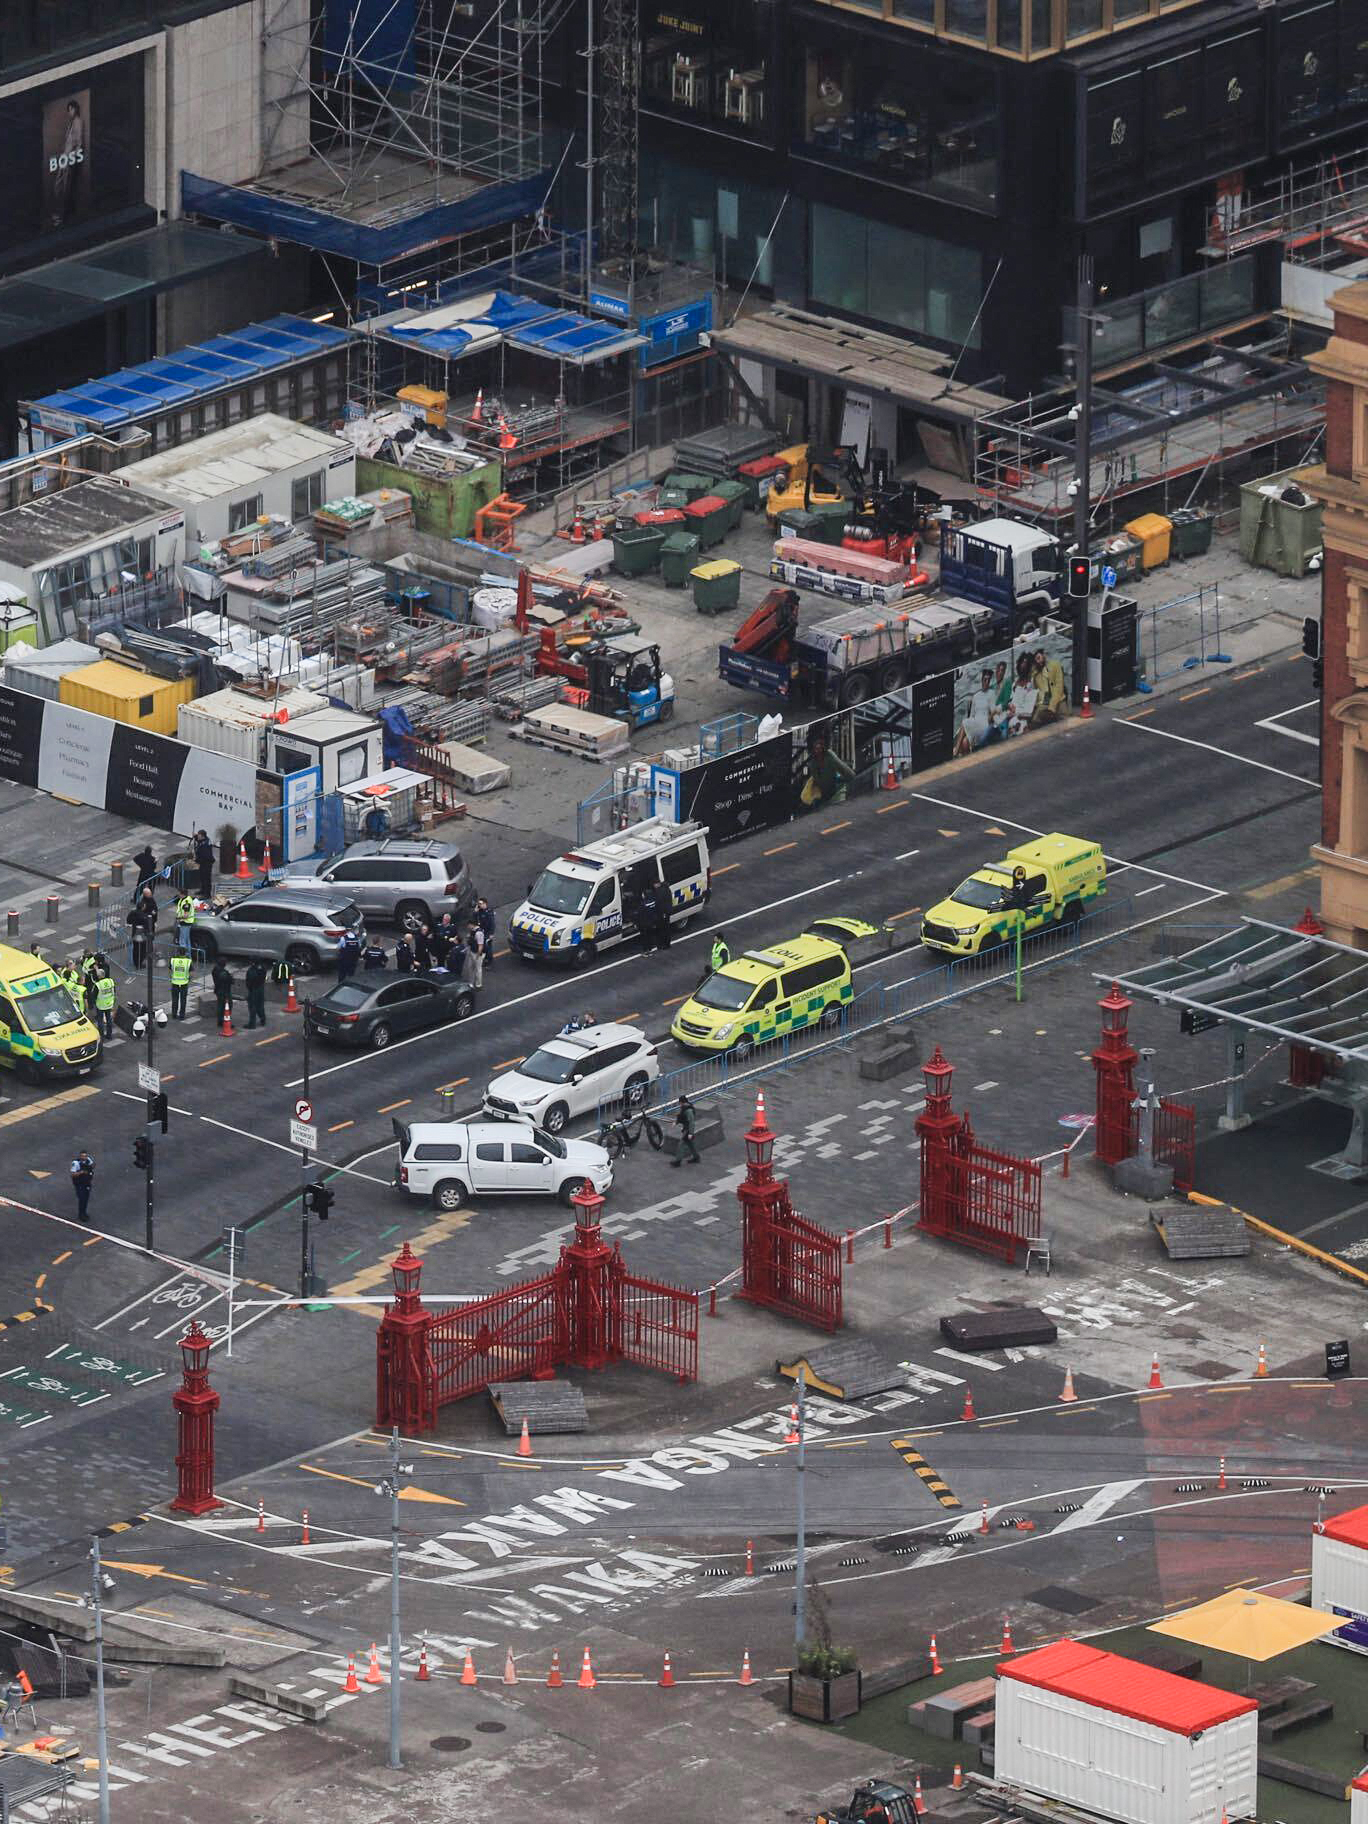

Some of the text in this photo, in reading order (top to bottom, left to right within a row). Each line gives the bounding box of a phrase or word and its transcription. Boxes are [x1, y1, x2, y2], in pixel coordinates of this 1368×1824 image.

[49, 148, 84, 172] BOSS
[129, 759, 144, 770] Food
[724, 761, 765, 781] COMMERCIAL
[739, 775, 751, 784] BAY
[199, 786, 253, 809] COMMERCIAL
[218, 802, 234, 812] BAY
[714, 784, 773, 811] Shop Dine Play
[520, 911, 559, 928] POLICE
[596, 913, 623, 933] POLICE
[792, 989, 817, 1005] INCIDENT
[397, 1487, 636, 1571] WAKA
